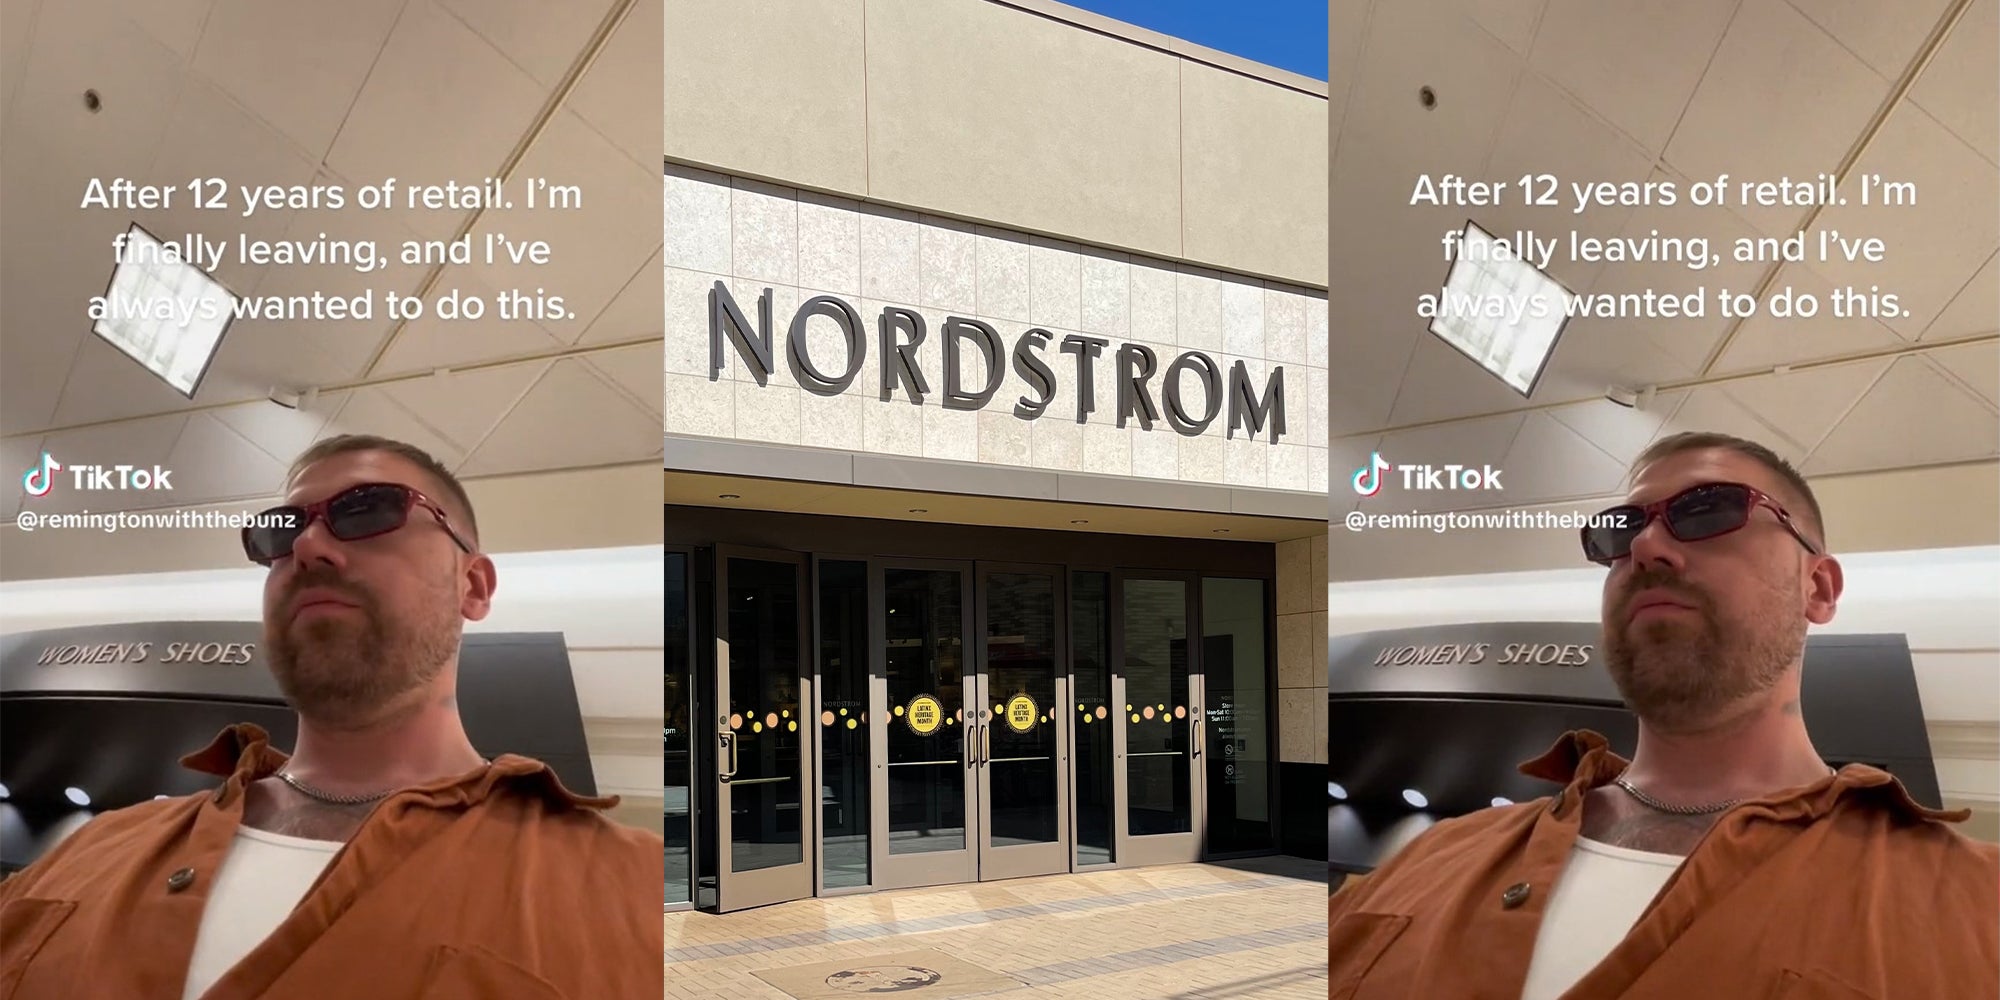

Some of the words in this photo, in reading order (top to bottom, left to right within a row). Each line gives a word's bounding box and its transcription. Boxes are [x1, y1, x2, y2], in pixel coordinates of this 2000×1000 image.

[708, 280, 1287, 445] NORDSTROM
[37, 642, 153, 665] WOMEN'S
[160, 642, 256, 665] SHOES
[1373, 643, 1491, 667] WOMEN'S
[1497, 643, 1594, 667] SHOES
